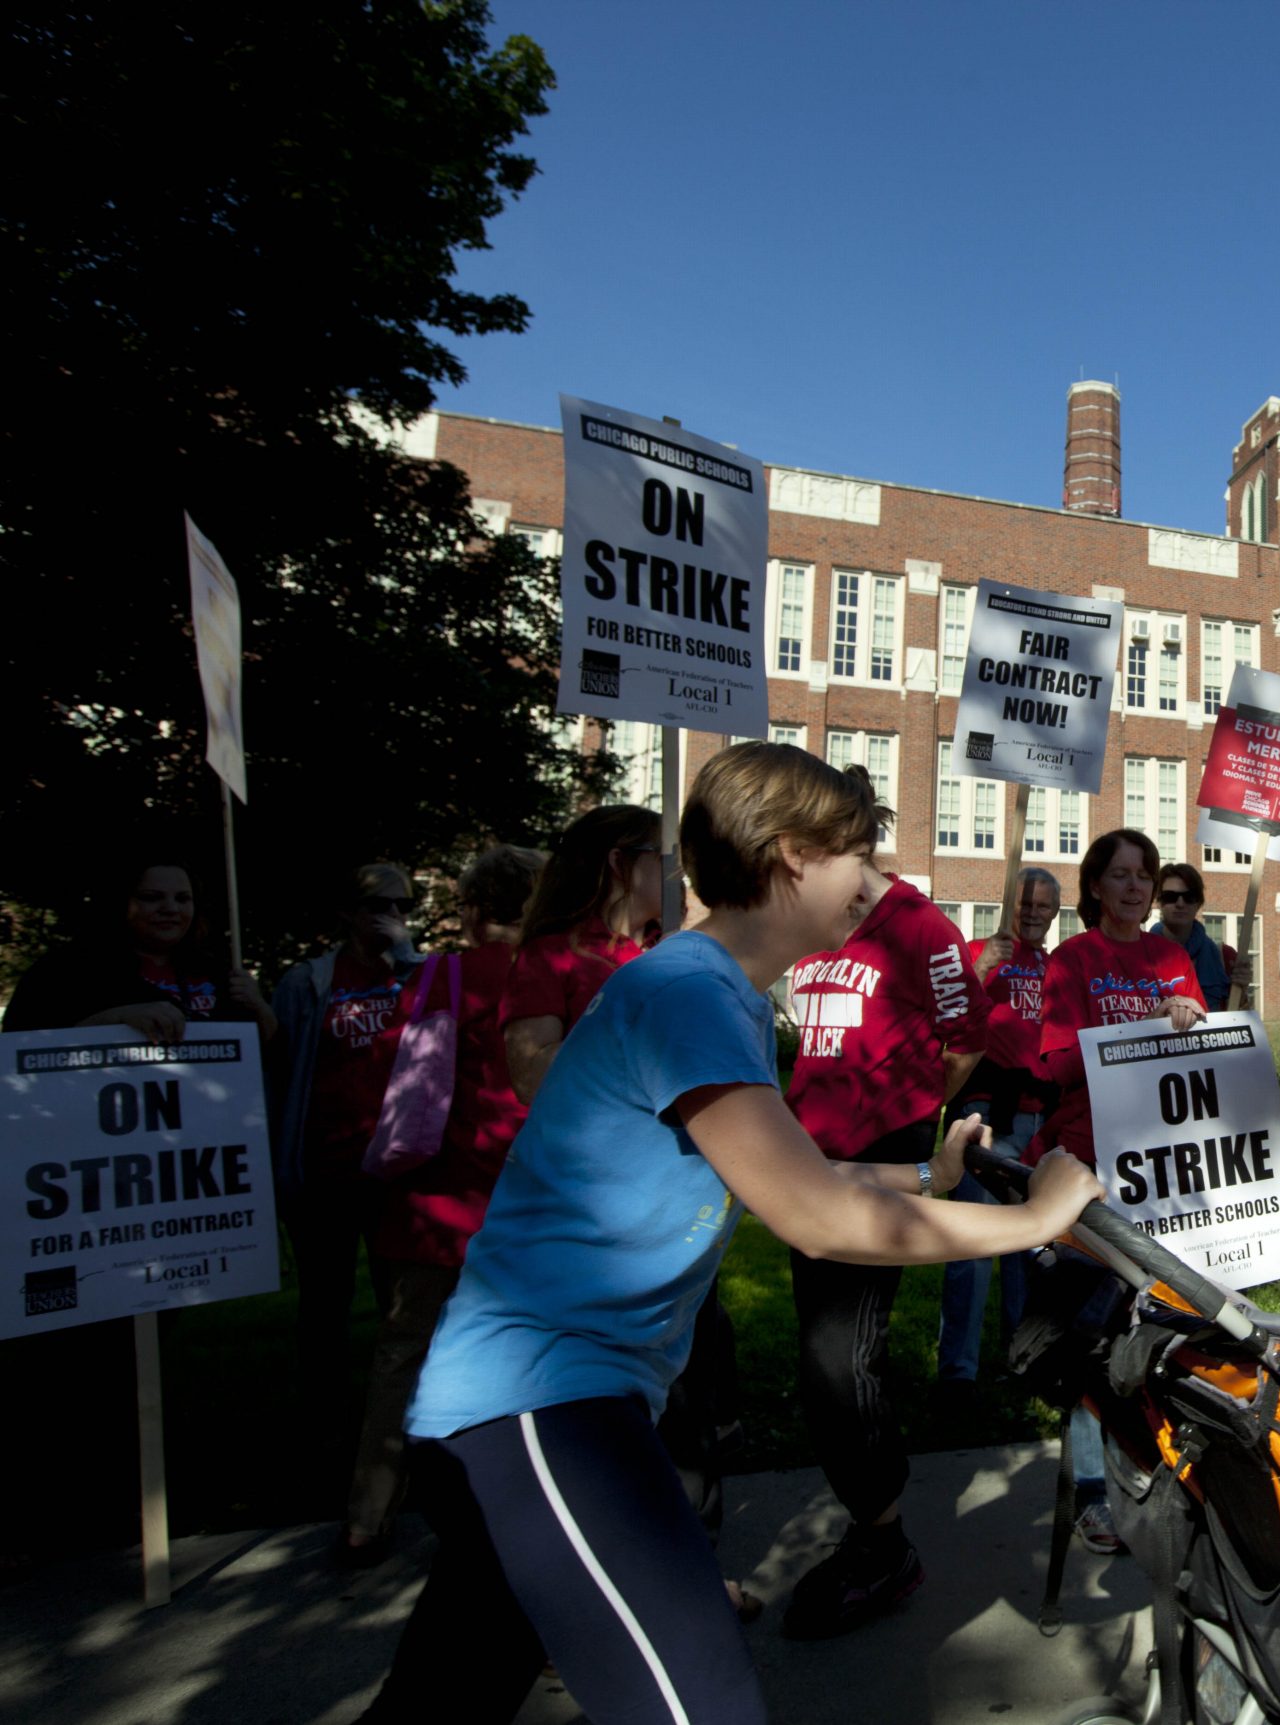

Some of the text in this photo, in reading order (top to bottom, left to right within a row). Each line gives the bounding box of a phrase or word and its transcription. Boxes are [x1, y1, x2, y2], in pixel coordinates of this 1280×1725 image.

[586, 420, 749, 489] CHICAGO PUBLIC SCHOOLS
[642, 478, 704, 547] ON
[584, 539, 750, 633] STRIKE
[587, 616, 752, 669] FOR BETTER SCHOOLS
[1019, 630, 1070, 661] FAIR
[582, 679, 618, 697] UNION
[646, 664, 680, 677] American
[681, 670, 717, 683] Federation
[727, 679, 754, 691] Teachers
[669, 678, 732, 706] Local 1
[978, 657, 1103, 700] CONTRACT
[685, 702, 718, 714] AFL-CIO
[1003, 696, 1068, 729] NOW!
[1026, 748, 1074, 766] Local 1
[1227, 753, 1255, 766] CLASES
[1257, 761, 1267, 769] DE
[1238, 765, 1265, 777] CLASES
[1267, 773, 1278, 781] DE
[1009, 991, 1042, 1010] UNI
[24, 1043, 236, 1069] CHICAGO PUBLIC SCHOOLS
[1104, 1030, 1250, 1062] CHICAGO PUBLIC SCHOOLS
[99, 1080, 182, 1136] ON
[1158, 1068, 1220, 1126] ON
[25, 1144, 252, 1220] STRIKE
[1115, 1129, 1275, 1205] STRIKE
[1135, 1195, 1280, 1237] OR BETTER SCHOOLS
[31, 1209, 255, 1257] FOR A FAIR CONTRACT
[1205, 1240, 1264, 1267] Local 1
[145, 1256, 229, 1284] Local 1
